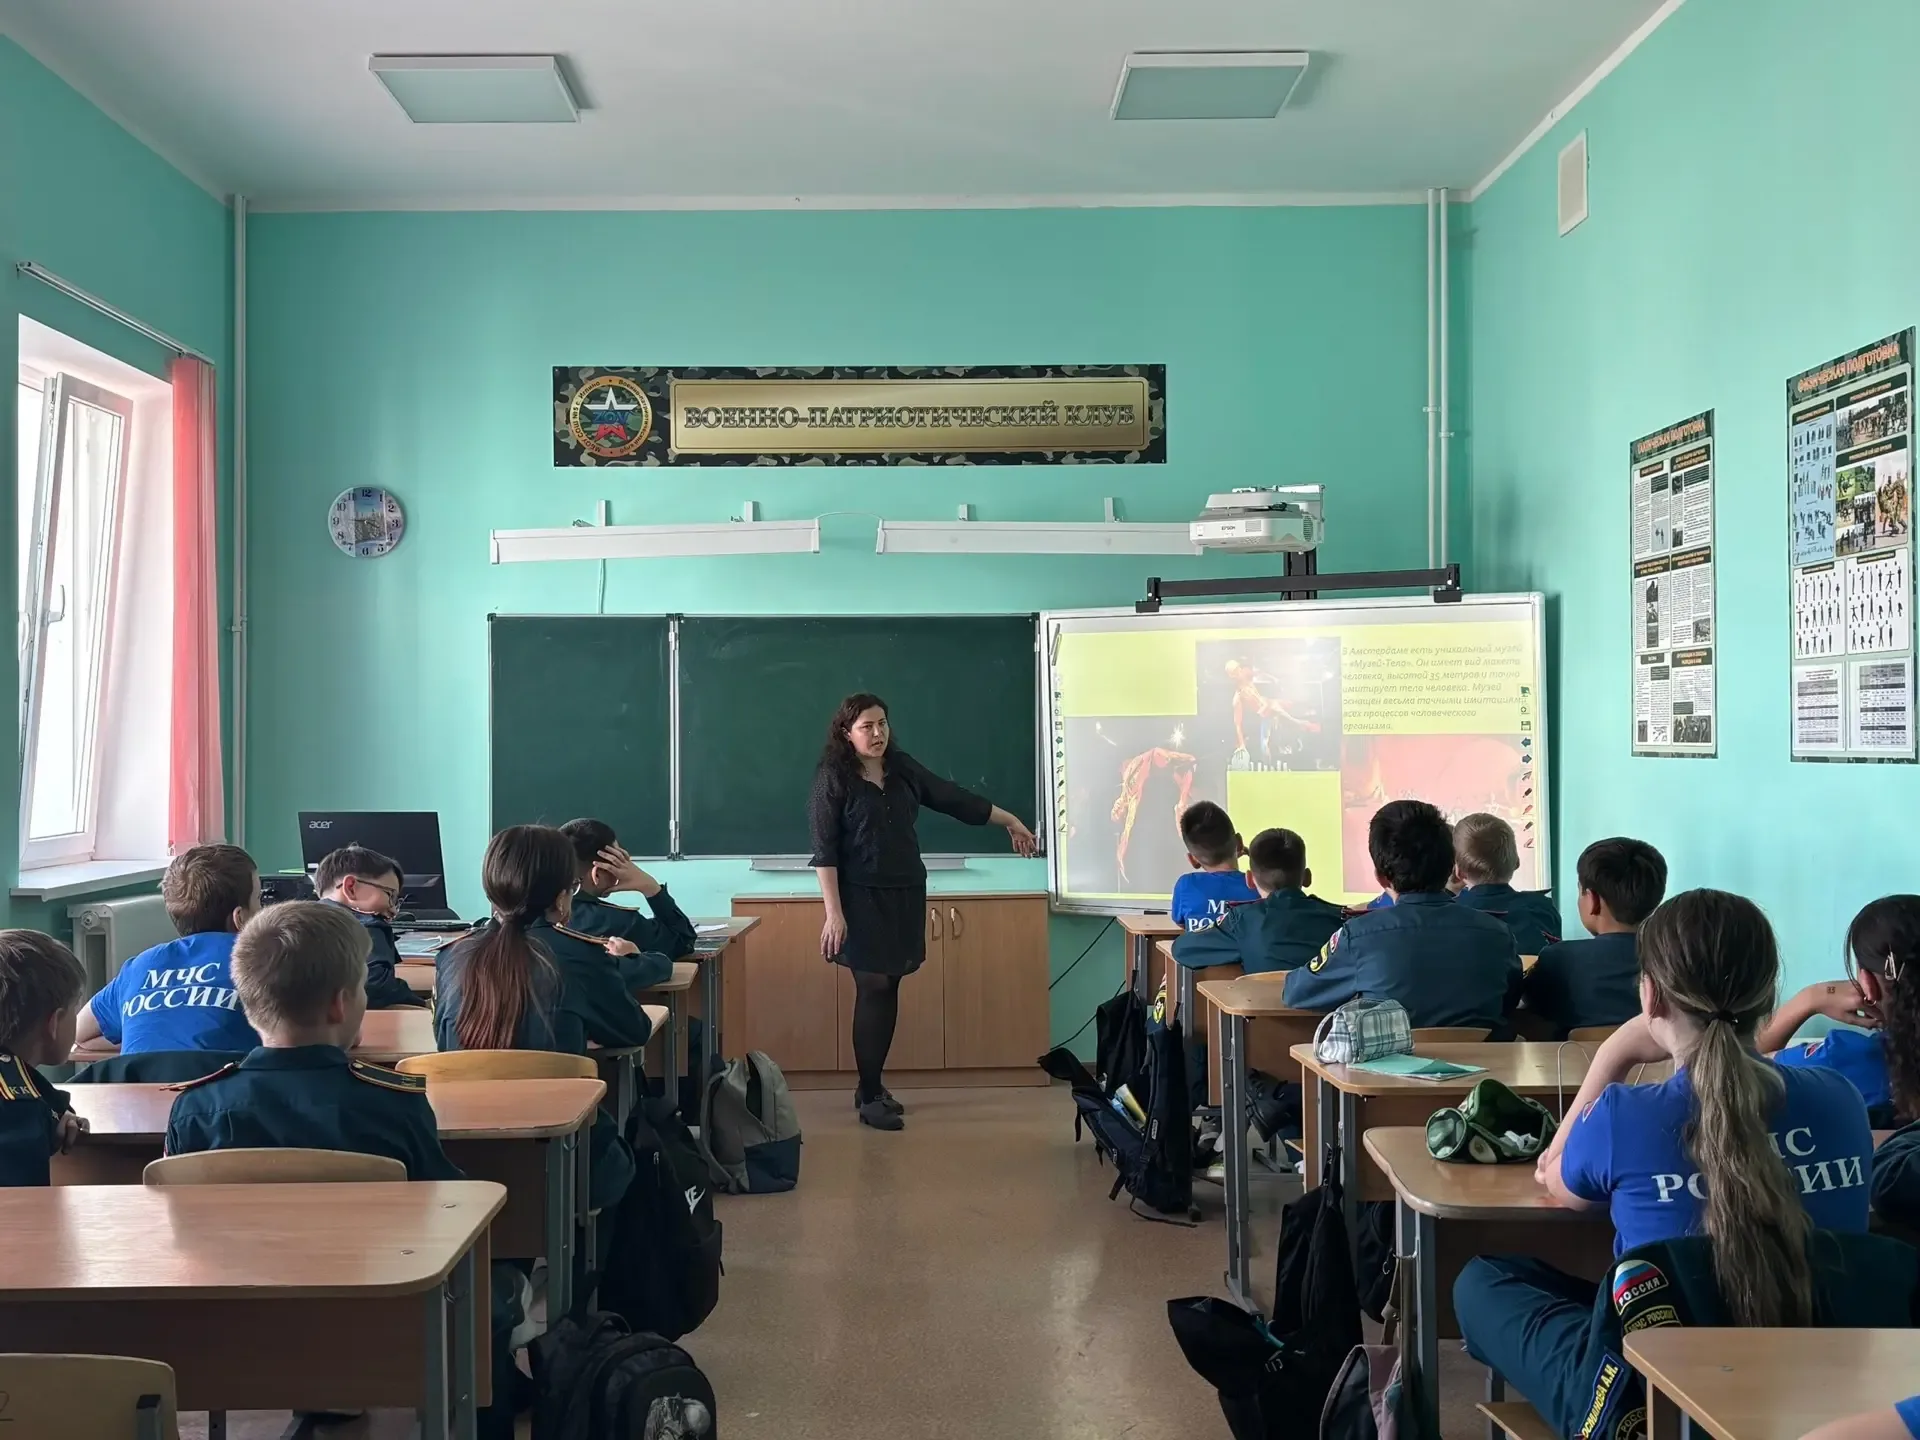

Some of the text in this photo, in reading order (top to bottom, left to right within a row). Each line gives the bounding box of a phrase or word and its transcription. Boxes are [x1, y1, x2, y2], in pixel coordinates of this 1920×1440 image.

[684, 400, 1136, 428] ВОЕННО-ПАТРИОТИЧЕСКИЙ КЛУБ
[362, 489, 372, 497] 12
[337, 503, 346, 511] 10
[1350, 647, 1408, 656] Амстердаме
[1435, 645, 1491, 656] уникальный
[1416, 658, 1429, 667] Он
[1464, 657, 1480, 665] вид
[1387, 671, 1428, 680] высотой
[1441, 672, 1481, 680] метров
[1472, 682, 1502, 692] Музей
[1363, 709, 1409, 719] процессов
[308, 820, 333, 829] acer
[141, 962, 221, 990] МЧС
[1618, 1277, 1661, 1307] РОССИЯ
[1621, 1411, 1647, 1432] РОСС
